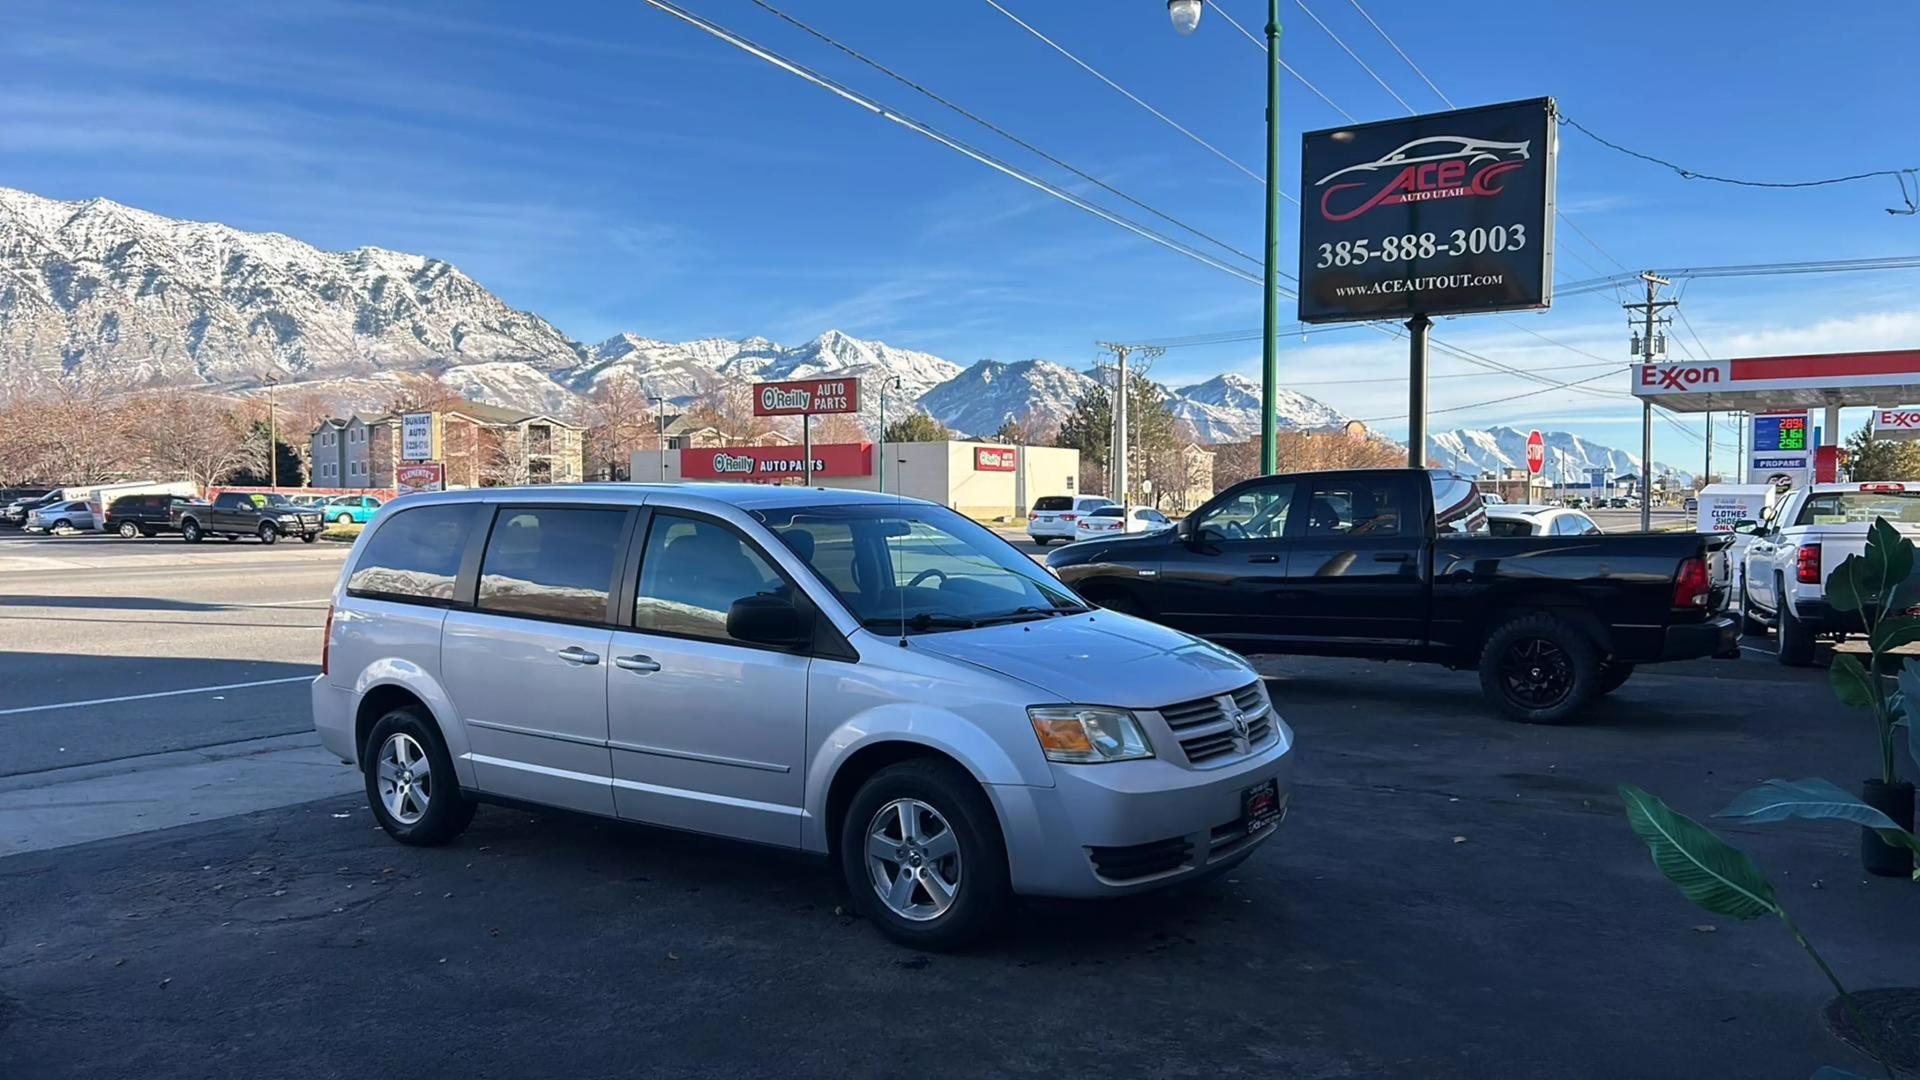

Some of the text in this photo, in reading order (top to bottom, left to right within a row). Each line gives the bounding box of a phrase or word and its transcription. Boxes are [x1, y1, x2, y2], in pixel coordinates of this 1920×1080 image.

[1399, 187, 1464, 202] AUTO UTAH
[1316, 223, 1526, 269] 385-888-3003
[762, 383, 844, 410] O'Reilly AUTO
[814, 397, 848, 410] PARTS
[409, 428, 426, 437] AUTO
[1528, 444, 1543, 460] STOP
[714, 453, 755, 474] O'Reilly
[760, 460, 787, 471] AUTO
[1711, 510, 1747, 518] CLOTHES
